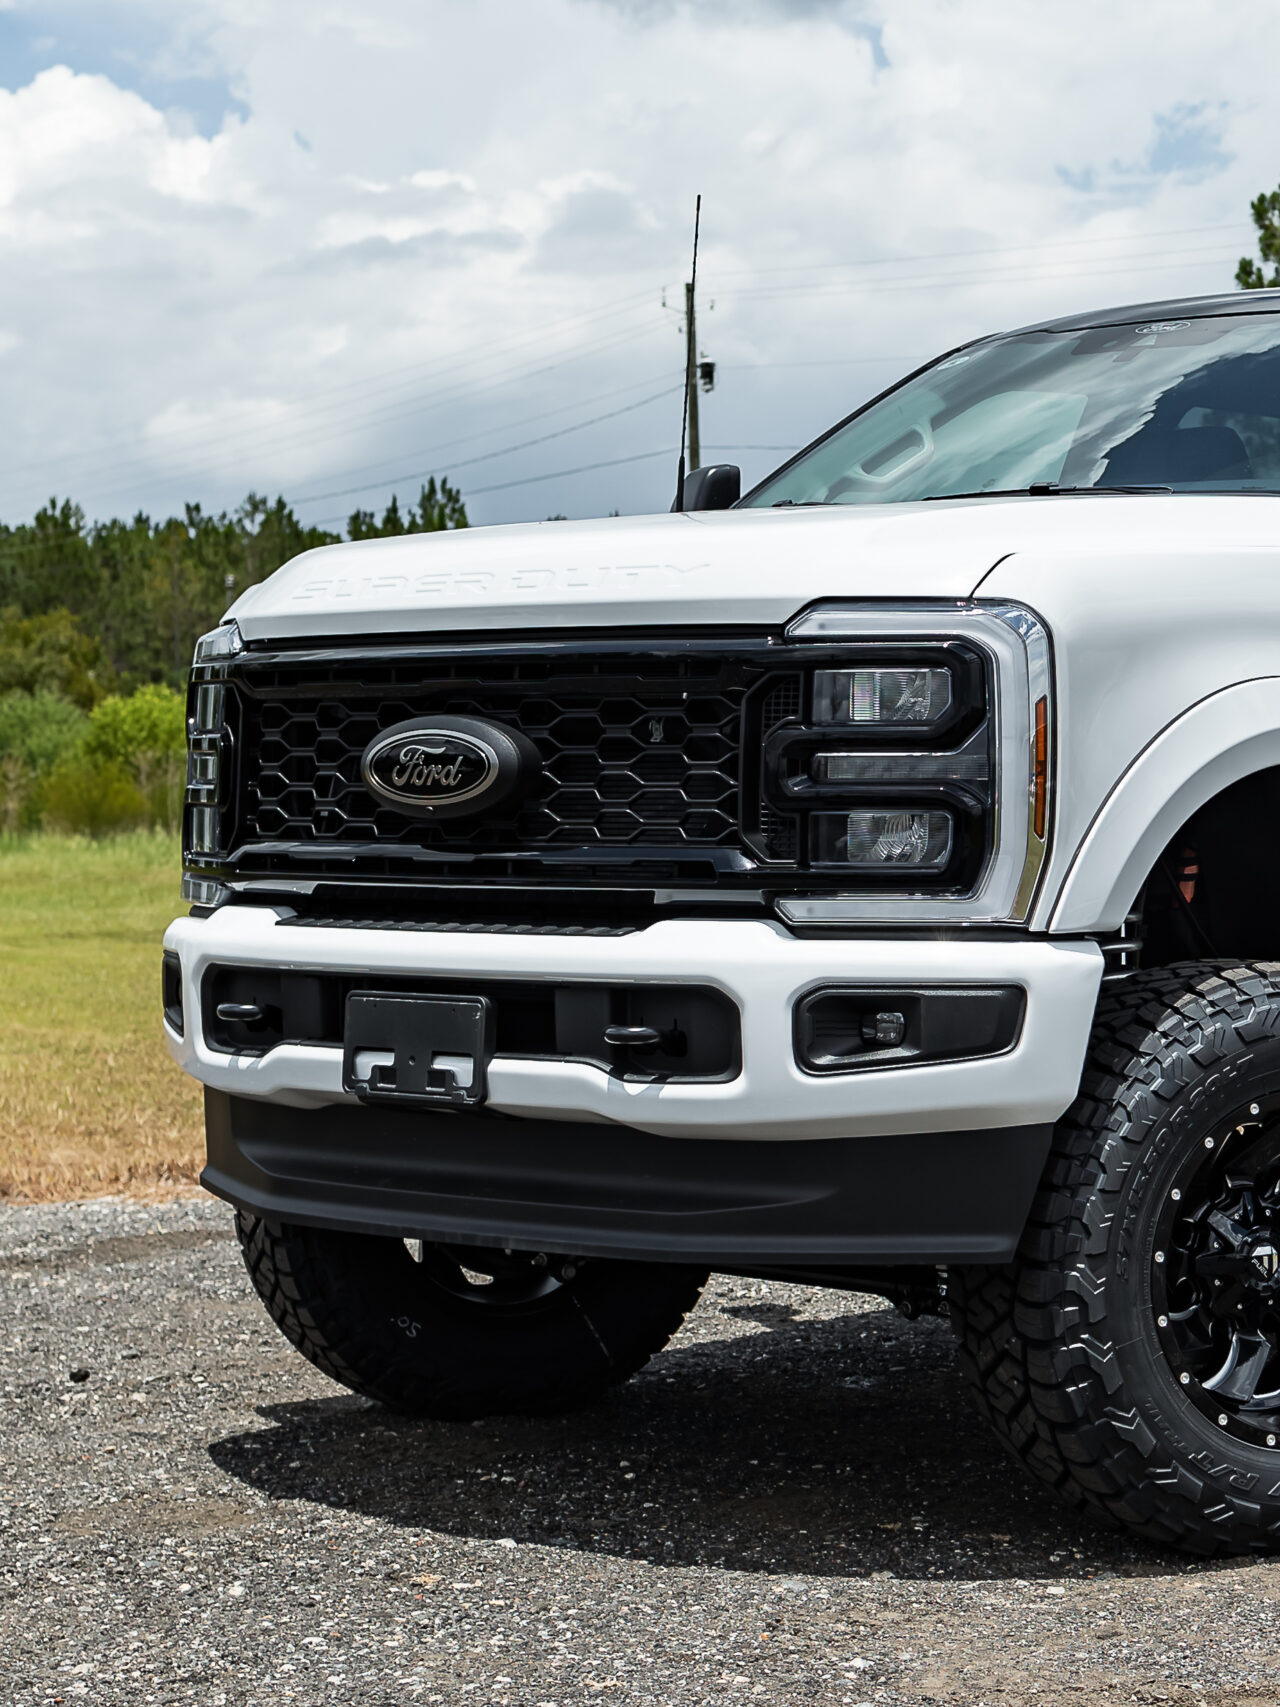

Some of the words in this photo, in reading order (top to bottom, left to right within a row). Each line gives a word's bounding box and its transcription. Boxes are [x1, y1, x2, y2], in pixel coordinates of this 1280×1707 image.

[292, 572, 496, 600] SUPER
[511, 563, 711, 591] DUTY
[392, 744, 464, 787] Ford
[1250, 1258, 1268, 1279] FUEL
[1187, 1450, 1261, 1492] R/T
